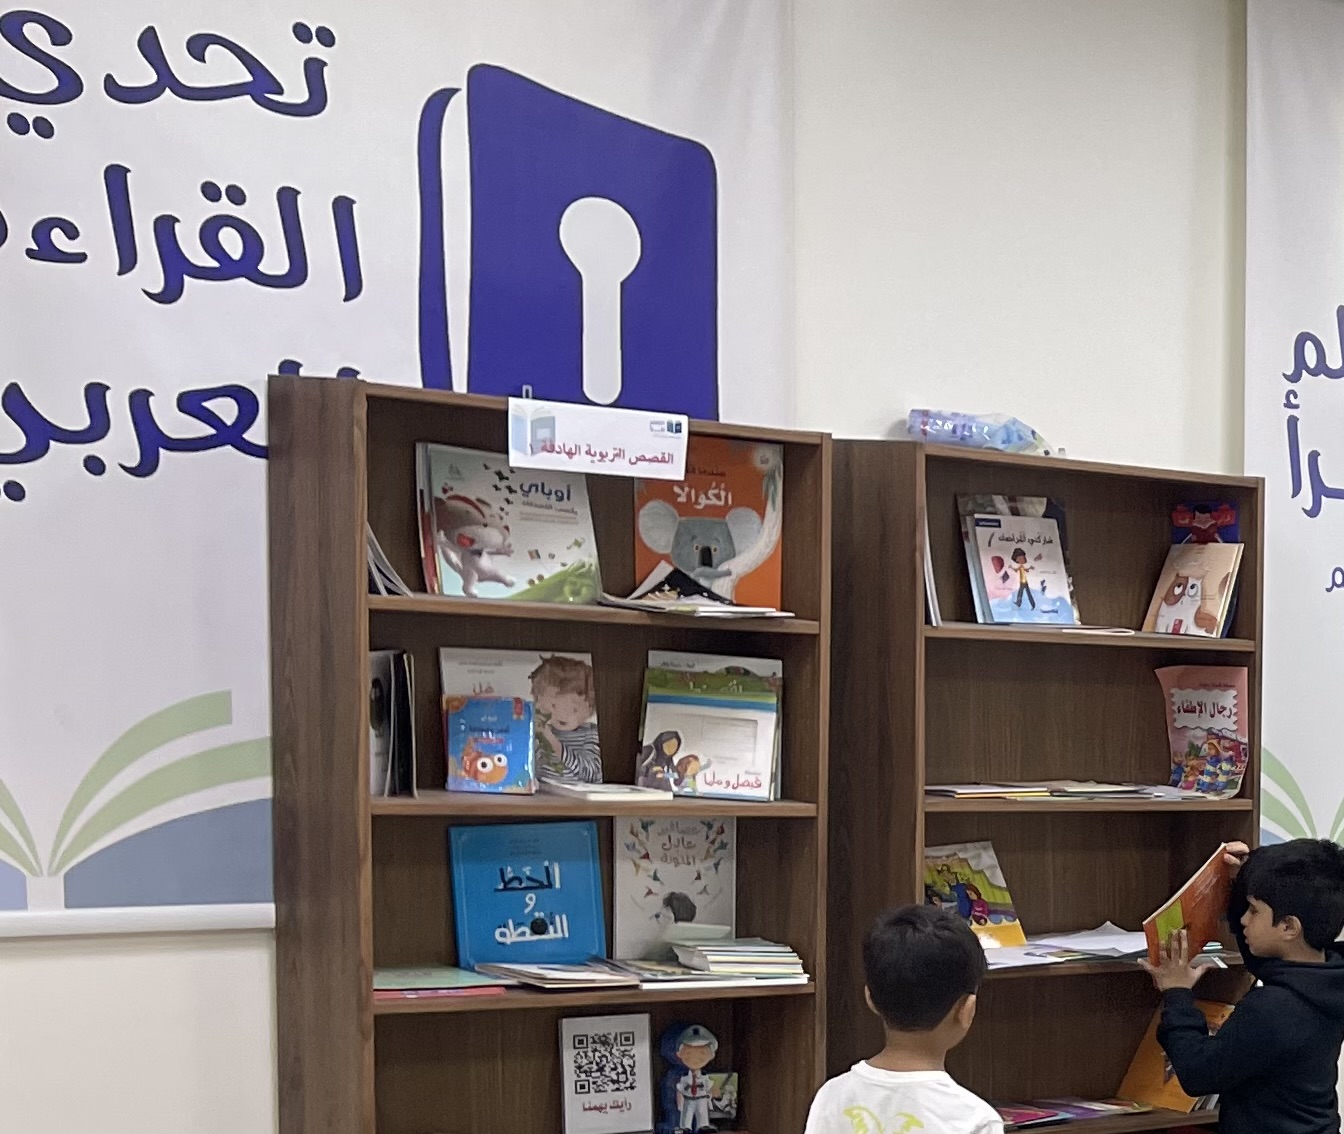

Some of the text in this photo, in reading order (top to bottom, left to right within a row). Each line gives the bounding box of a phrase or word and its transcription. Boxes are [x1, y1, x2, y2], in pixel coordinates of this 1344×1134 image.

[0, 10, 336, 139] تحدي
[0, 163, 363, 304] القراء
[585, 444, 626, 464] التربوية
[629, 452, 674, 466] القصص
[1209, 701, 1232, 719] رجال
[494, 860, 561, 892] الخط
[524, 893, 536, 914] و
